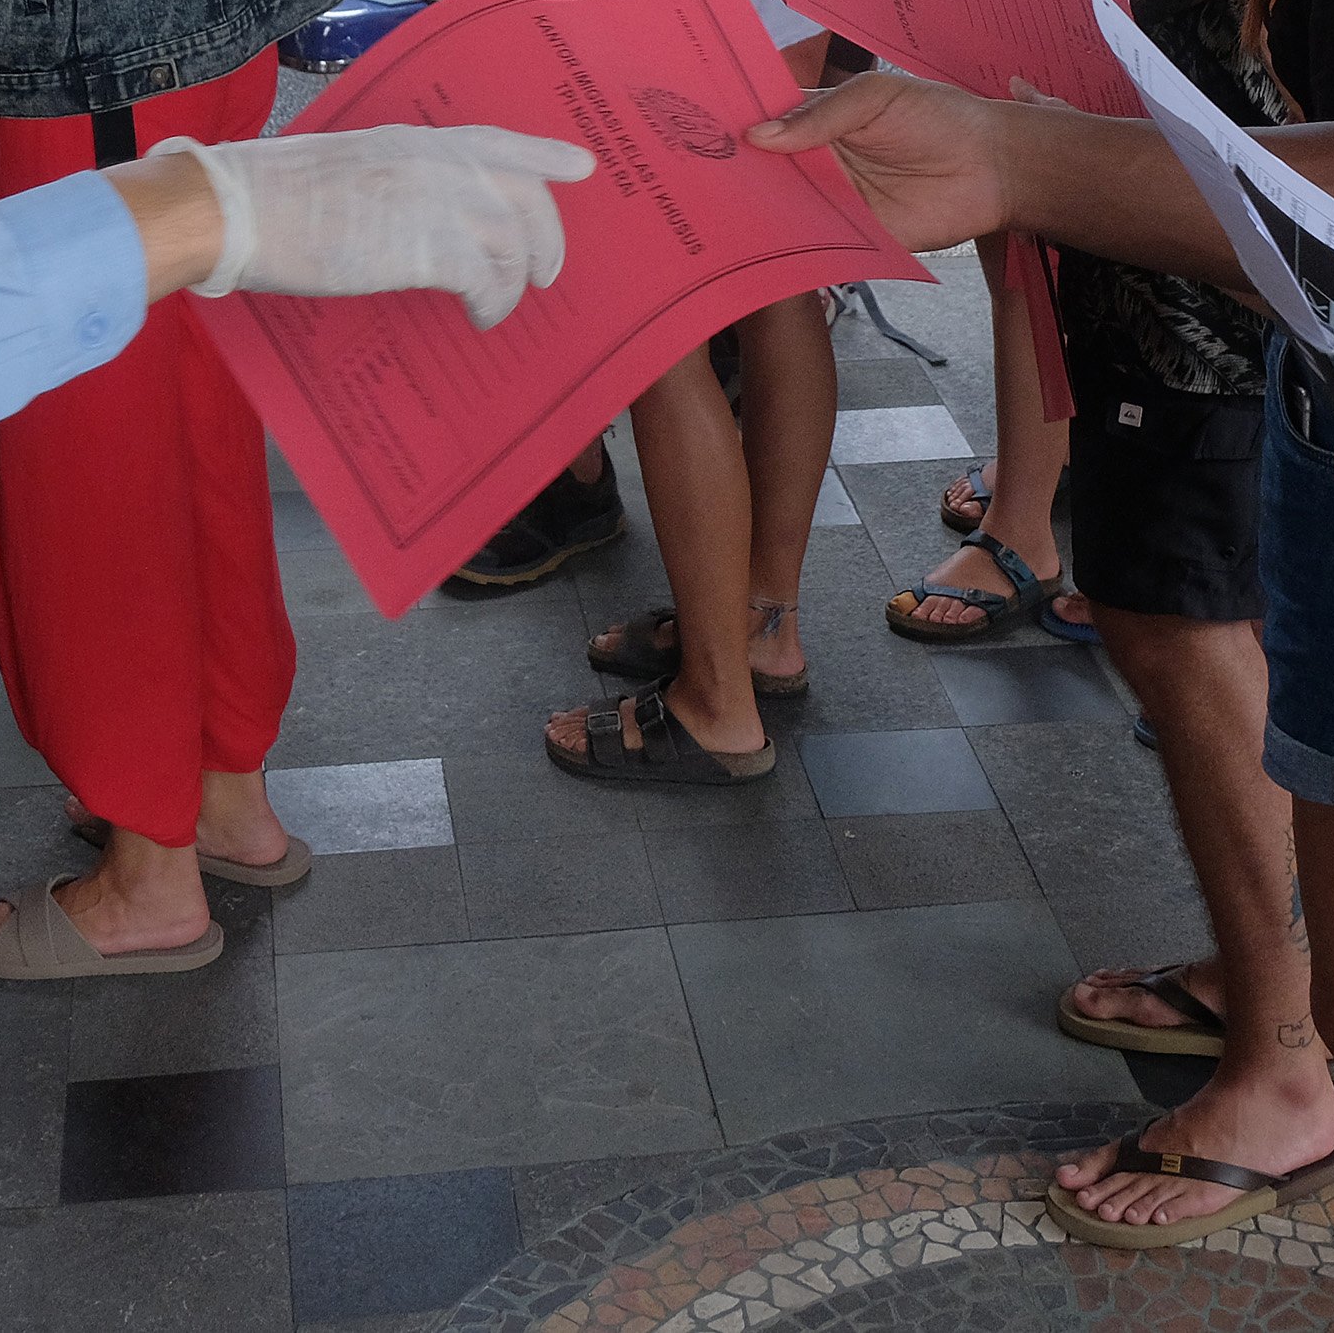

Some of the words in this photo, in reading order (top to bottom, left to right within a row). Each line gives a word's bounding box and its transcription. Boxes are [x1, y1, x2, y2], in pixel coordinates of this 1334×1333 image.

[534, 13, 582, 68] KANTOR
[572, 69, 623, 133] IMIGRASI
[615, 134, 657, 184] KELAS
[654, 192, 706, 256] KHUSUS
[554, 80, 578, 106] TPI
[568, 106, 620, 170] NGURAH
[611, 169, 640, 199] RAI
